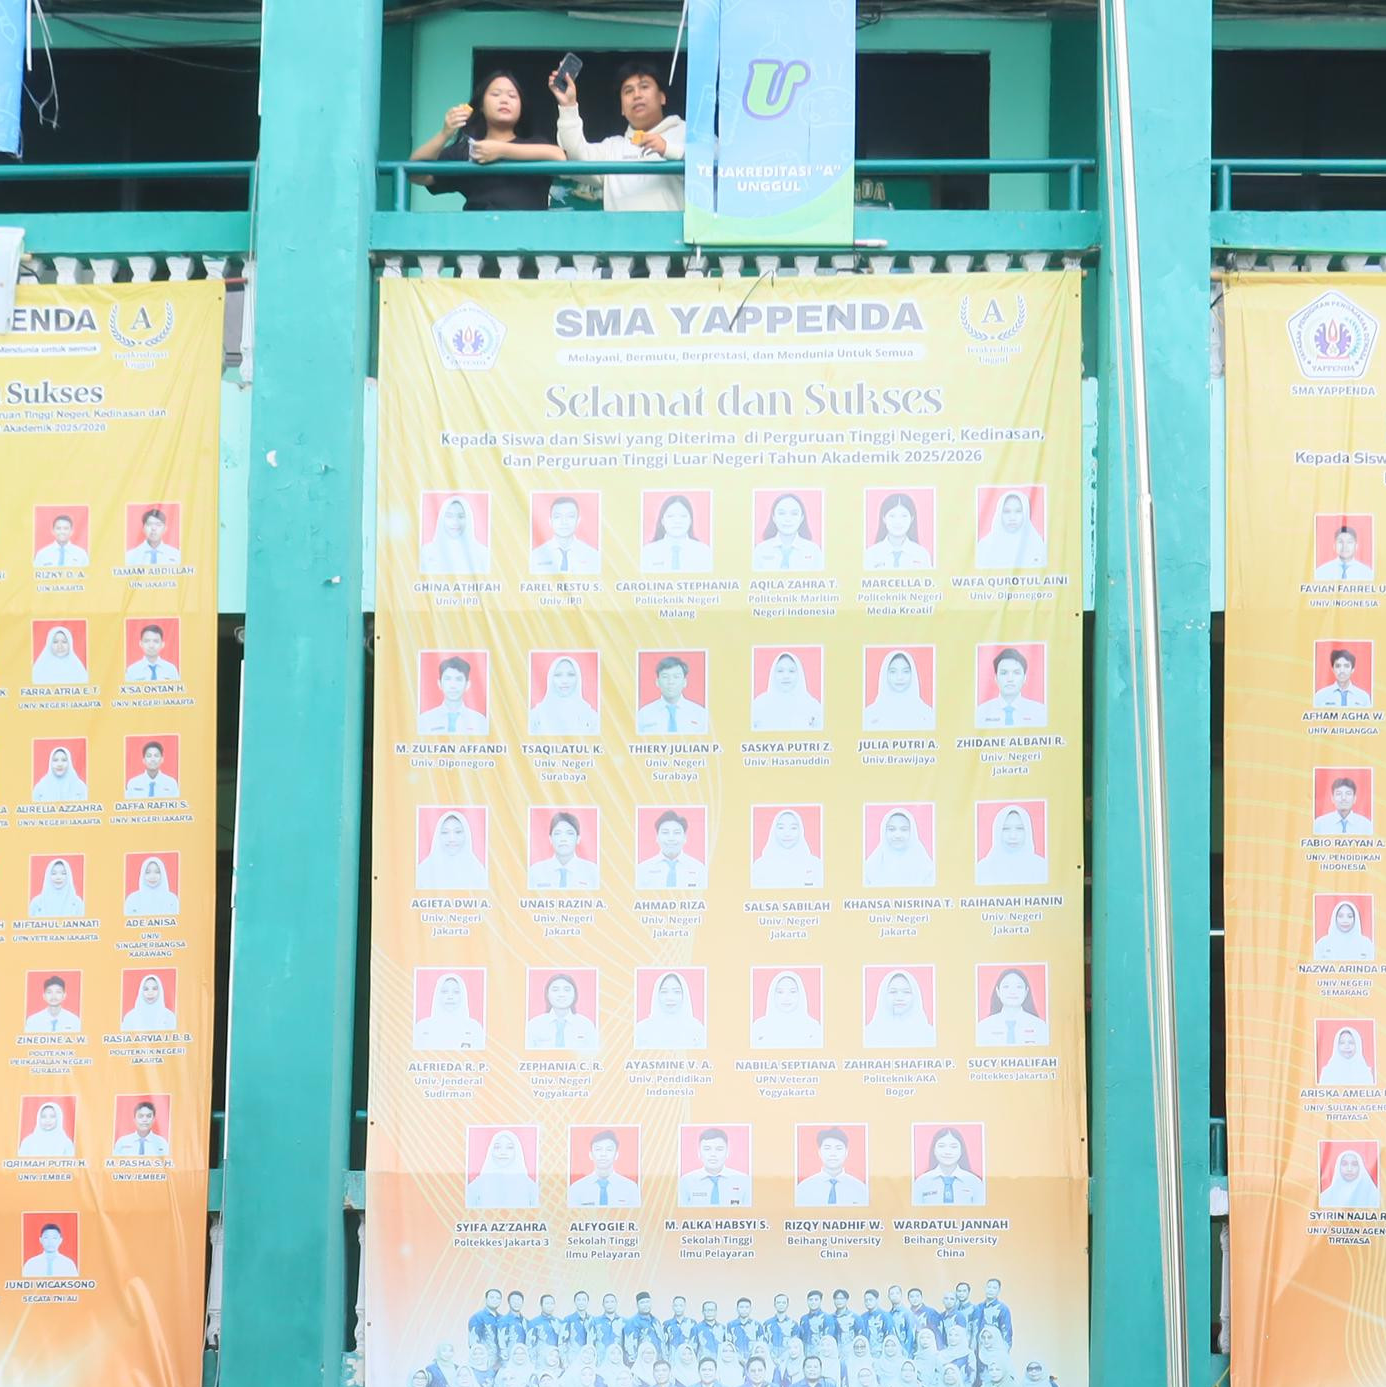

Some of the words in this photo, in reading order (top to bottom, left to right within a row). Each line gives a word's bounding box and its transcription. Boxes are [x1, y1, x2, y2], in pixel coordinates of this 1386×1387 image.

[743, 59, 811, 120] U
[697, 165, 812, 180] TERAKREDITASI
[737, 181, 801, 192] UNGGUL
[130, 306, 154, 330] A
[981, 300, 1004, 324] A
[556, 307, 655, 338] SMA
[670, 302, 924, 336] YAPPENDA
[6, 382, 103, 406] Sukses
[1292, 386, 1314, 396] SMA
[1317, 386, 1375, 396] YAPPENDA
[547, 384, 706, 417] Selamat
[718, 384, 792, 417] dan
[805, 384, 943, 417] Sukses
[1296, 453, 1350, 466] Kepada
[396, 744, 409, 754] M.
[413, 744, 456, 754] ZULFAN
[460, 744, 507, 754] AFFANDI
[456, 1223, 487, 1232] SYIFA
[665, 1221, 678, 1230] M.
[682, 1221, 712, 1230] ALKA
[715, 1221, 757, 1230] HABSYI
[760, 1221, 769, 1230] S.
[893, 1220, 957, 1230] WARDATUL
[961, 1220, 1008, 1230] JANNAH
[5, 1280, 33, 1289] JUNDI
[36, 1280, 95, 1289] WICAKSONO
